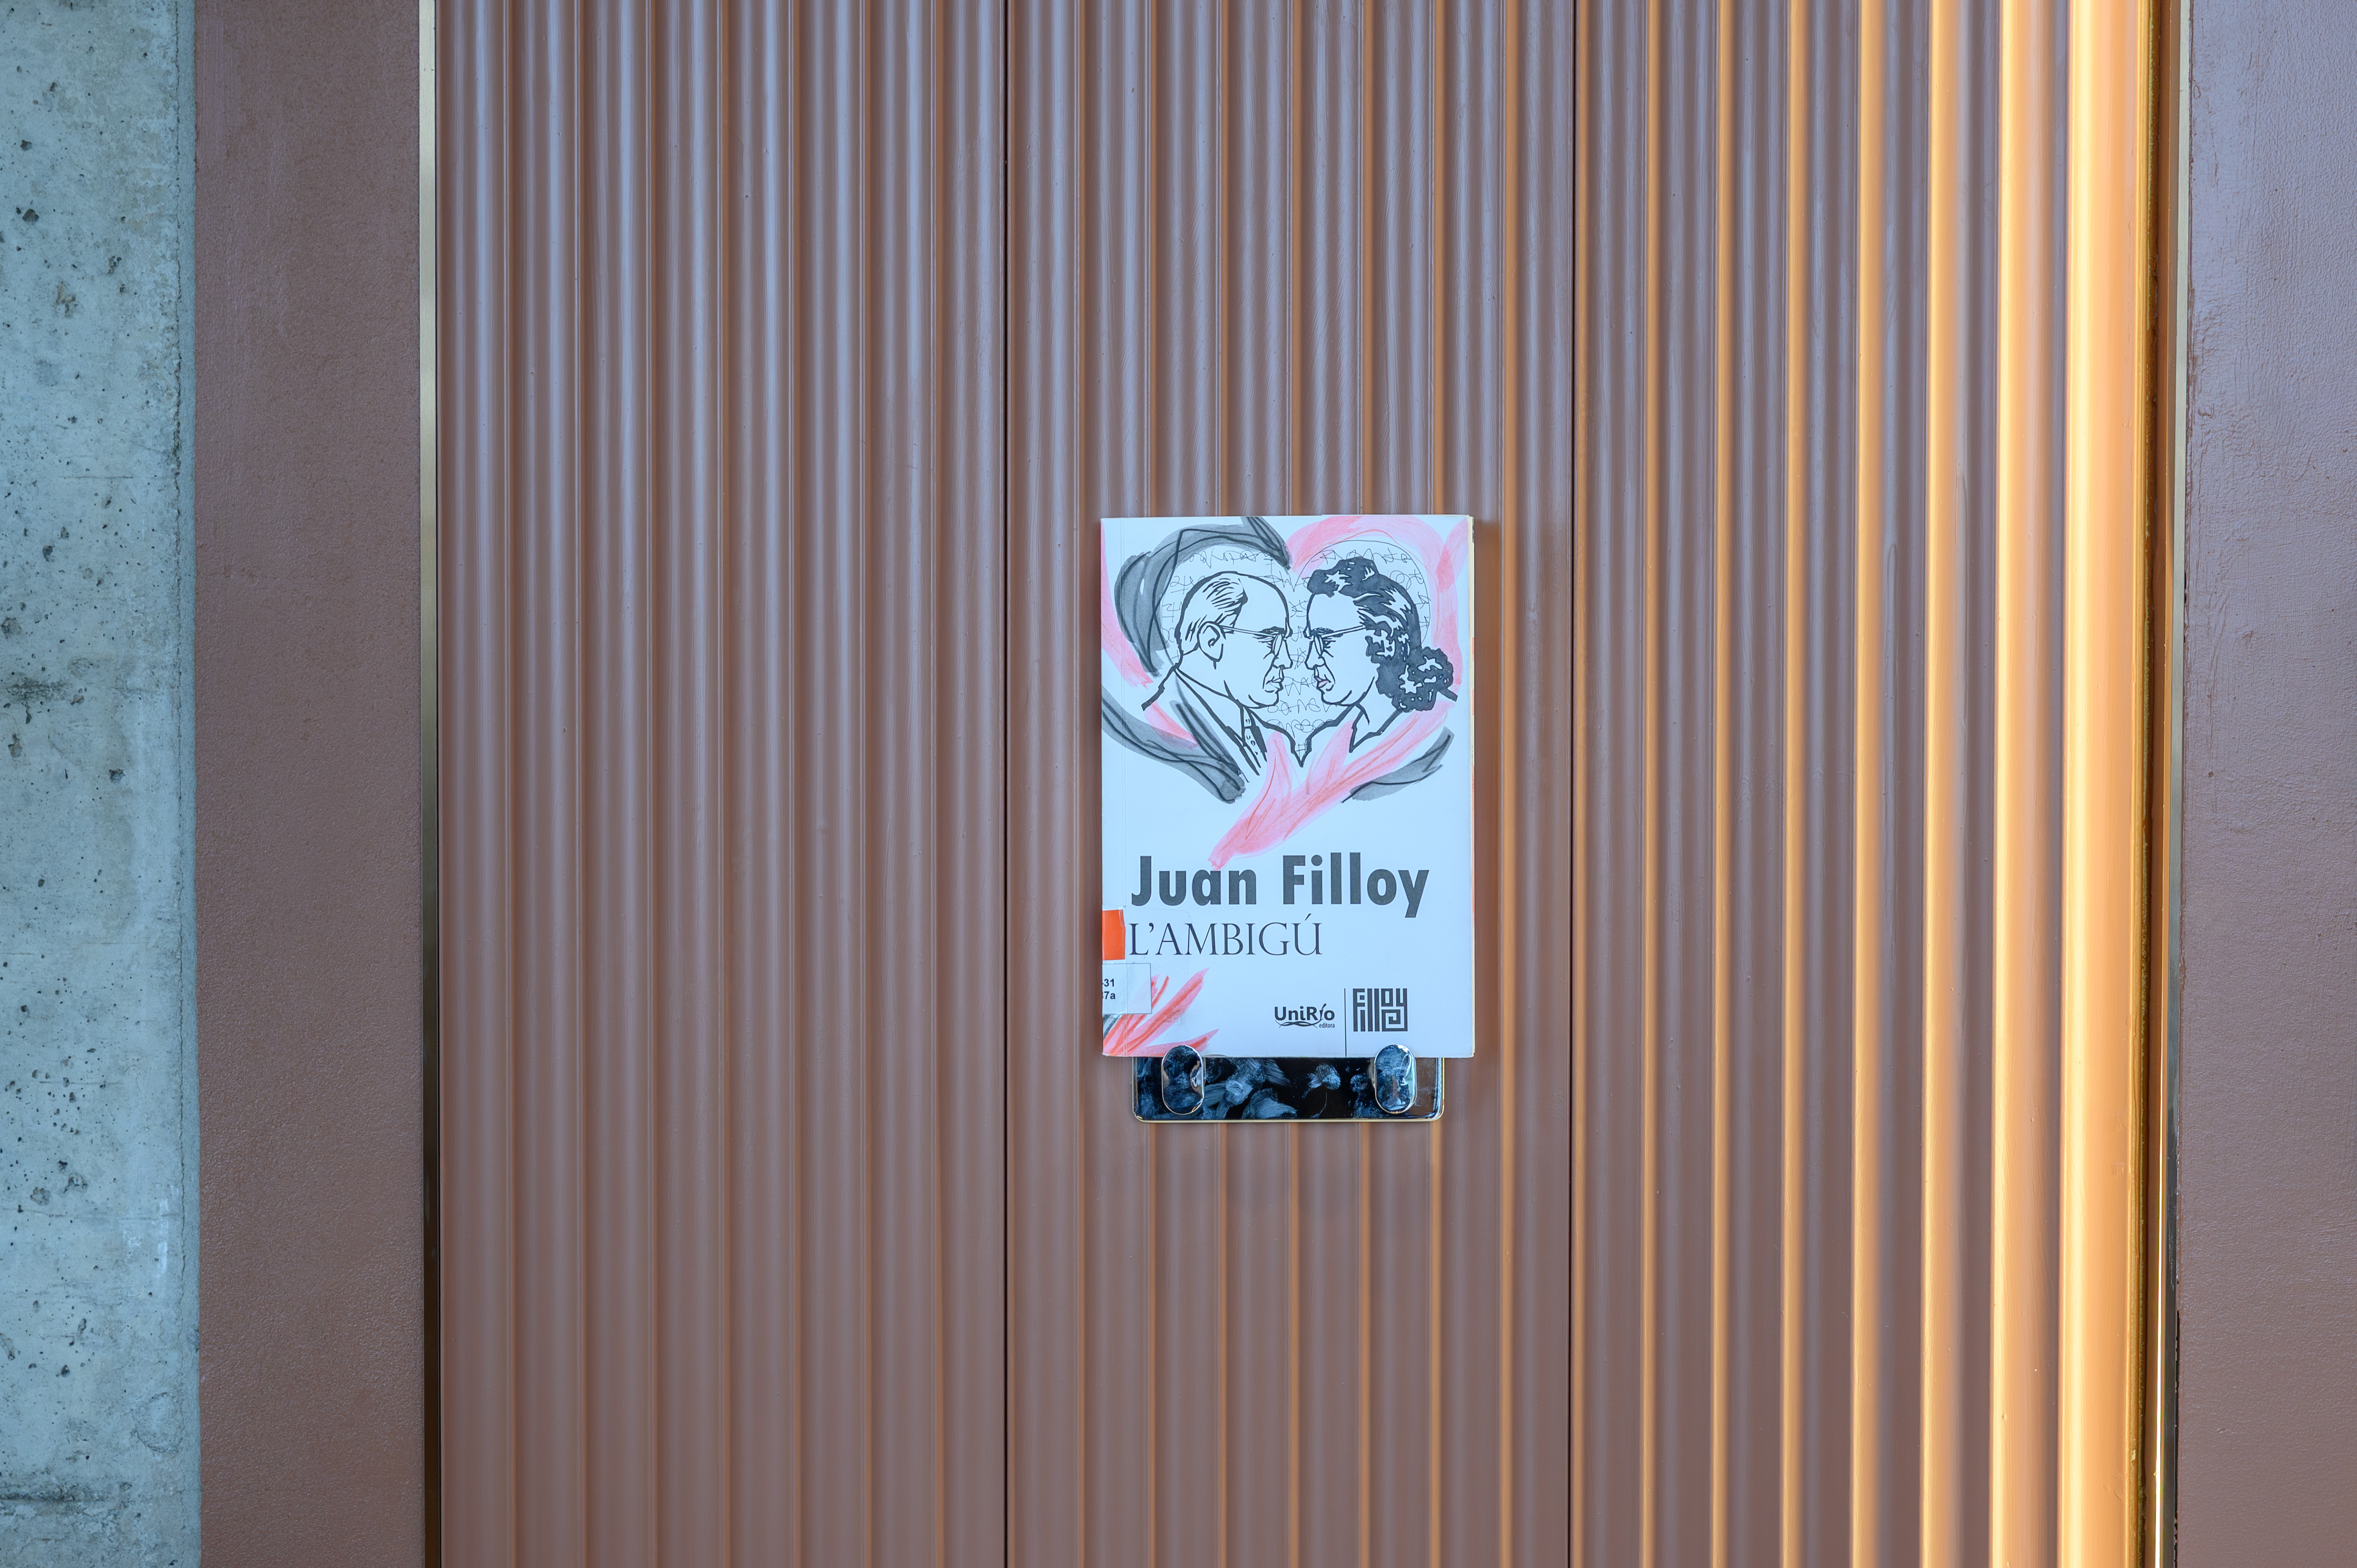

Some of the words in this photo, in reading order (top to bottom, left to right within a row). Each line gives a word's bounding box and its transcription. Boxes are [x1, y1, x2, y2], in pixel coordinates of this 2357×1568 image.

[1131, 856, 1257, 906] Juan
[1283, 852, 1430, 918] Filloy
[1129, 913, 1323, 956] L'AMBIGÚ
[1275, 1003, 1335, 1021] UniRío
